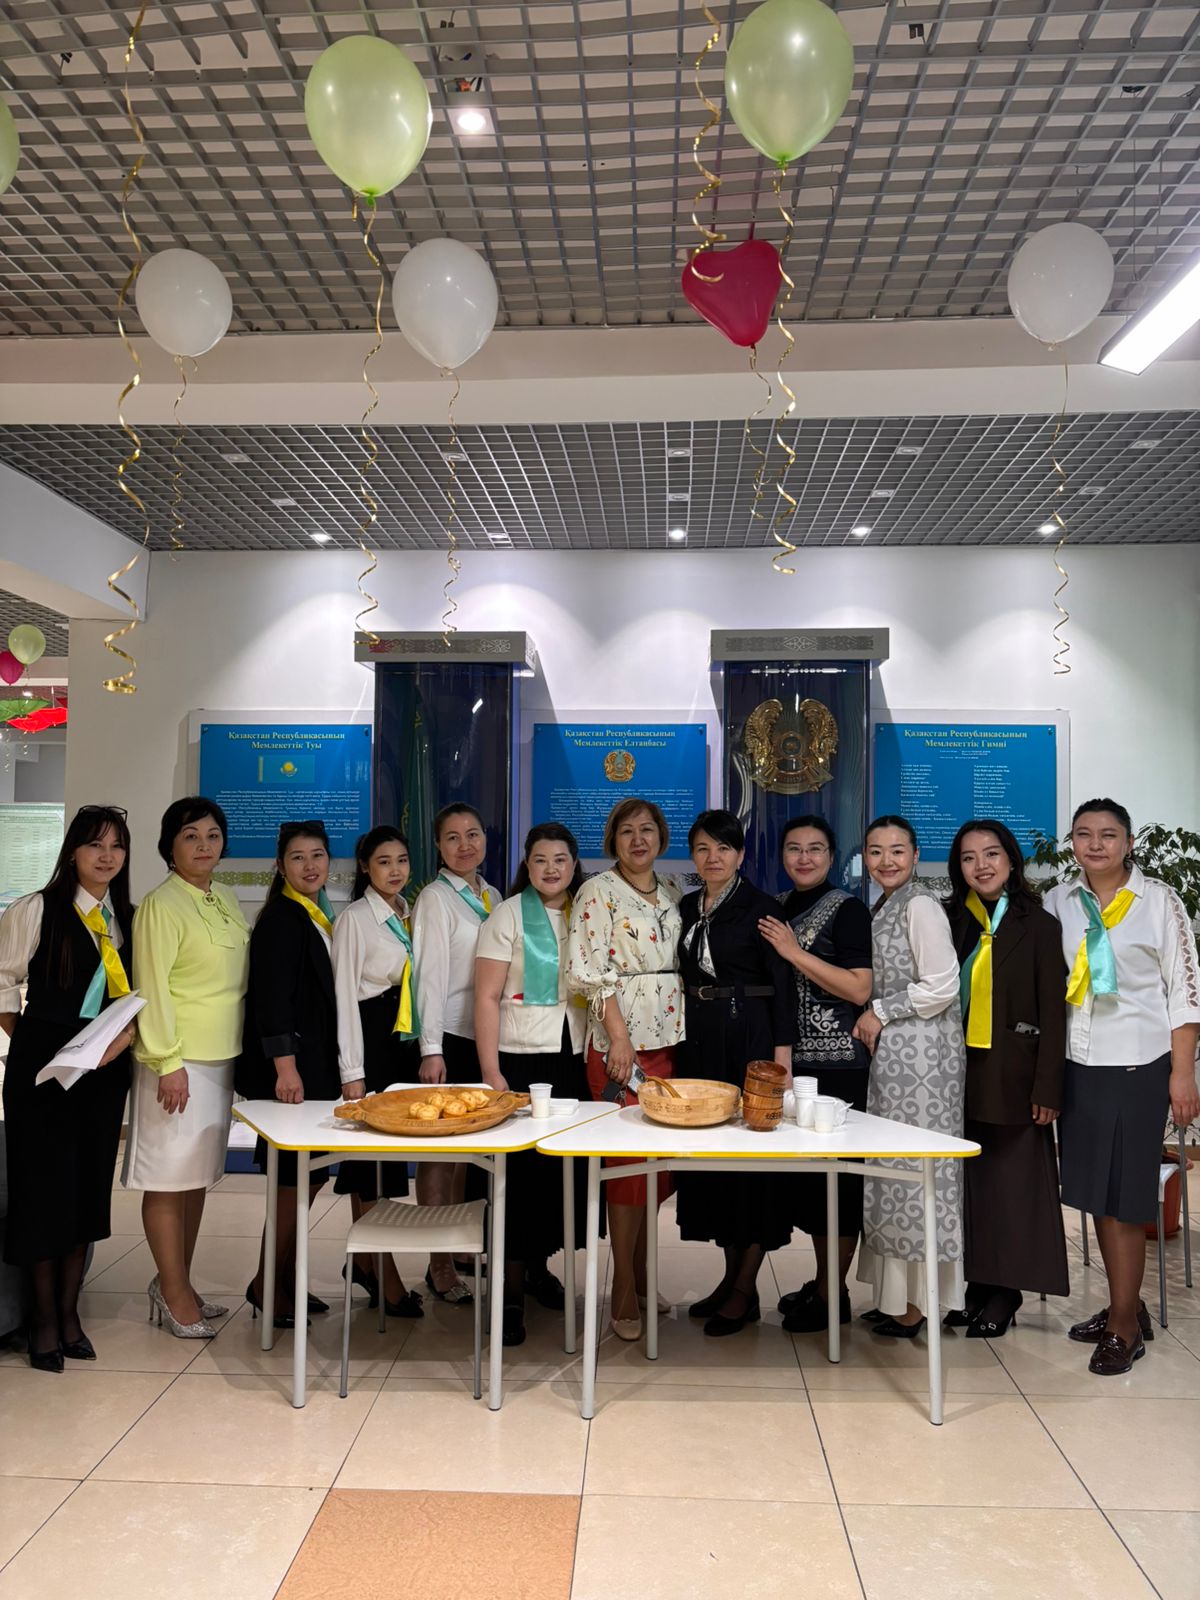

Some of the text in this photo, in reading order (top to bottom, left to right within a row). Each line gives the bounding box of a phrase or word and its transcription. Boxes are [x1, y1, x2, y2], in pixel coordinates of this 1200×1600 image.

[228, 731, 270, 741] Қазақстан
[565, 729, 604, 738] Қазақстан
[904, 729, 947, 738] Қазақстан
[251, 741, 322, 750] Мемлекеттік Туы
[925, 740, 1007, 748] Мемлекеттік Гимні
